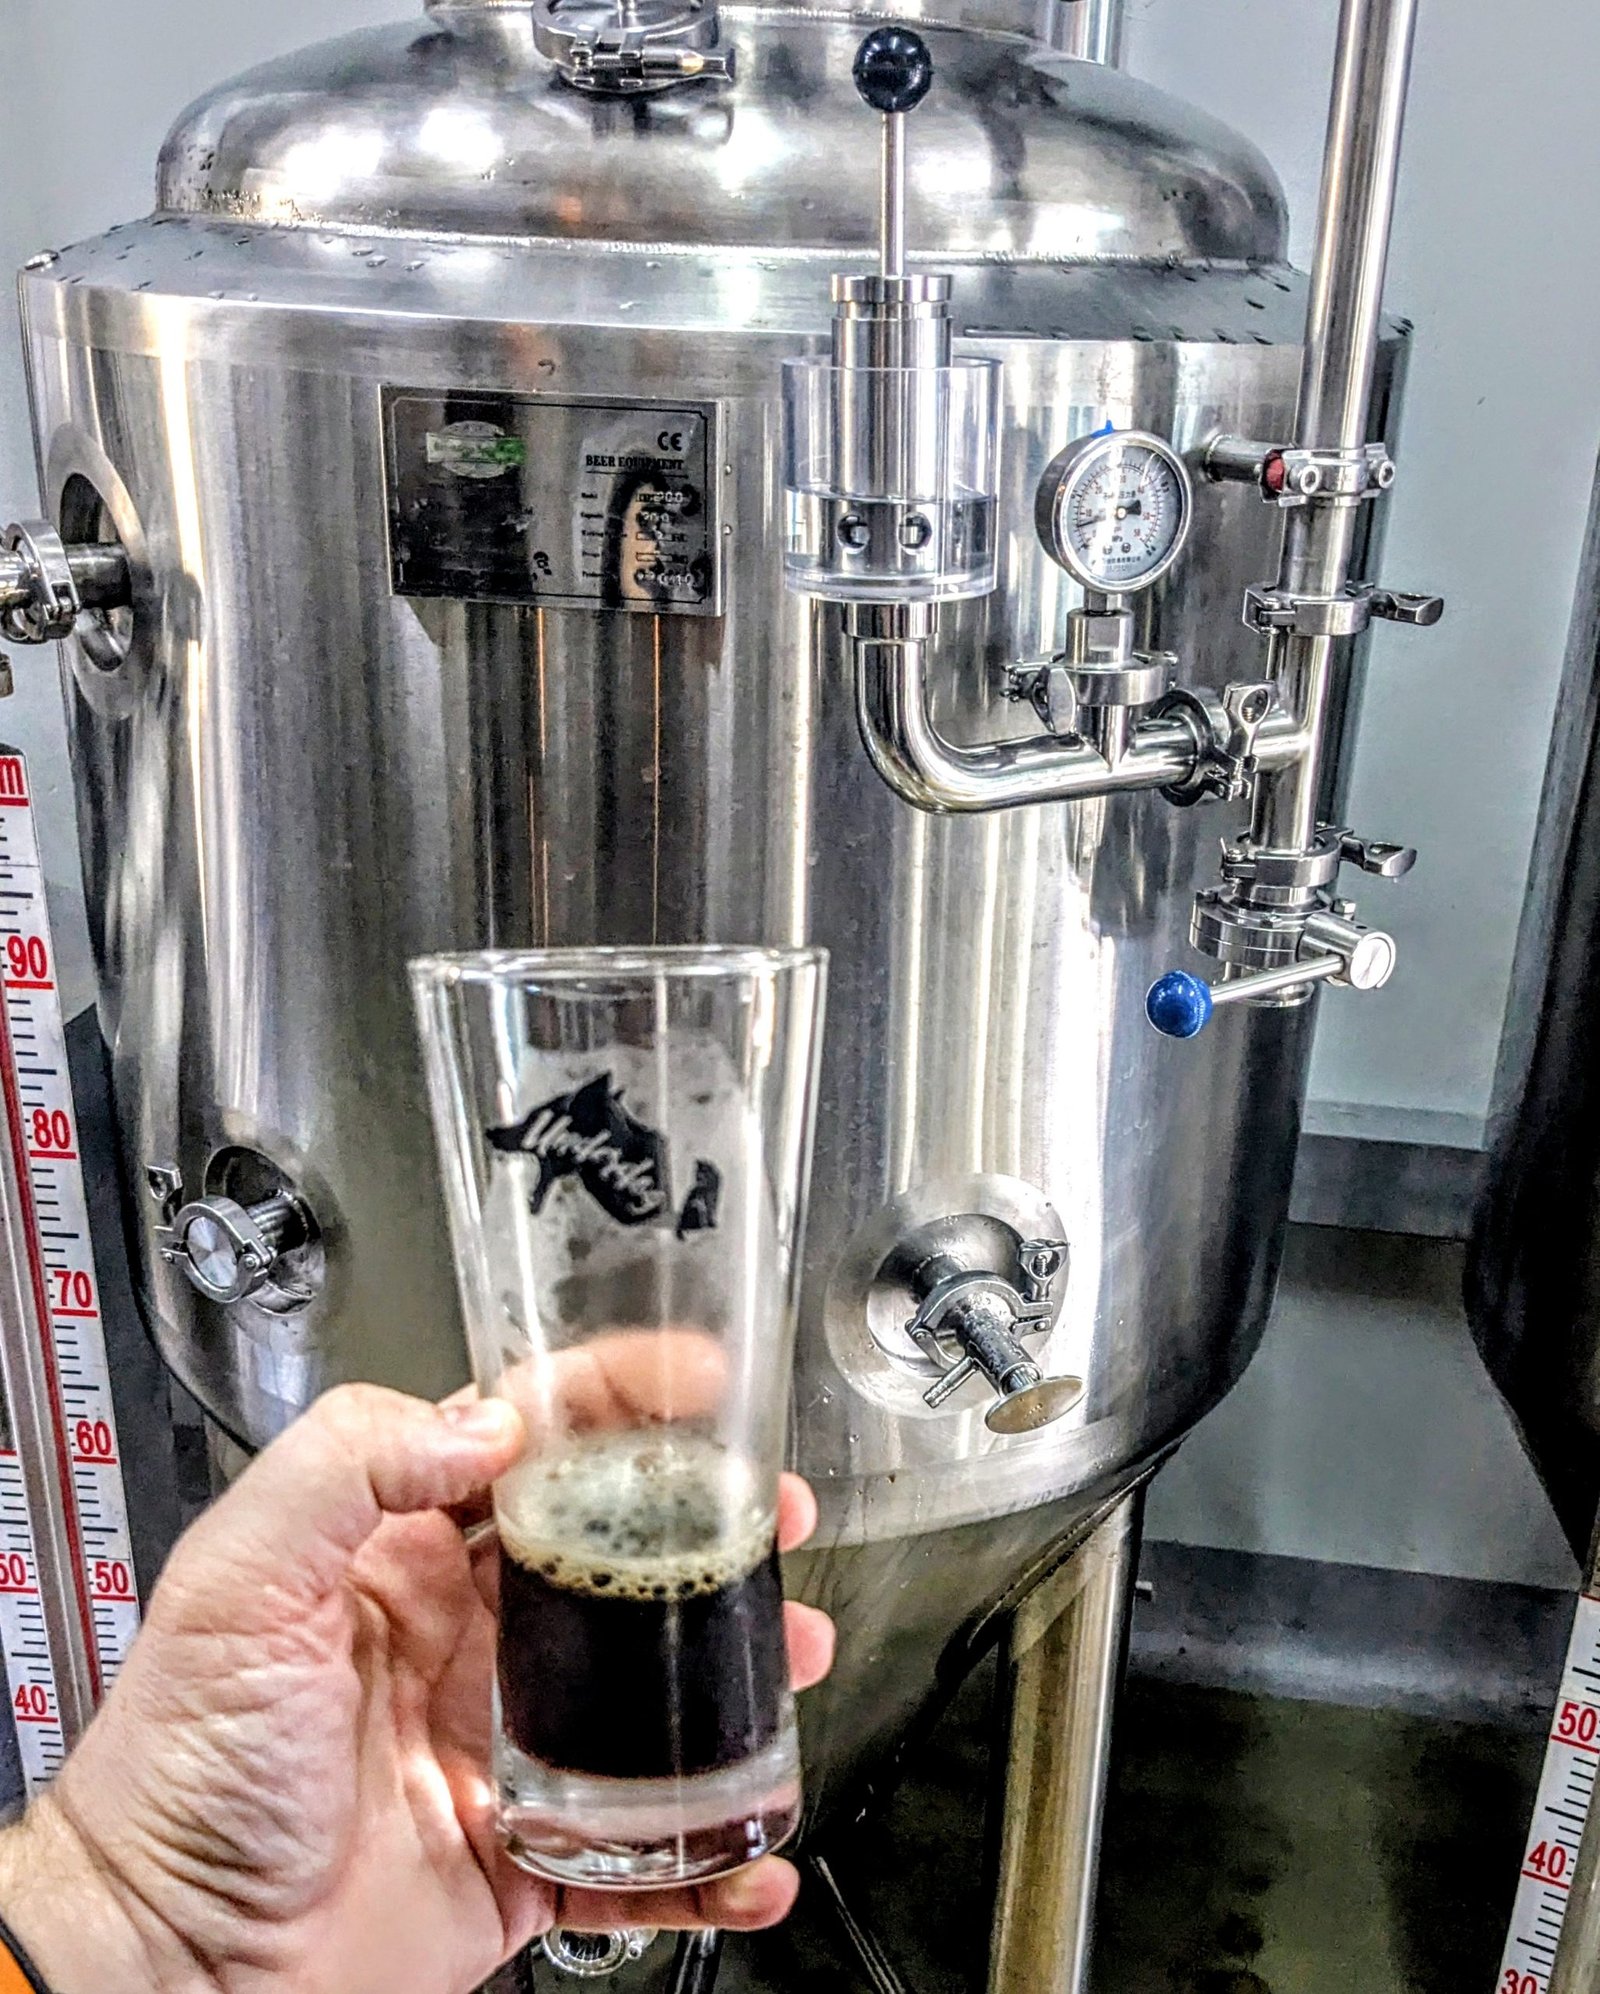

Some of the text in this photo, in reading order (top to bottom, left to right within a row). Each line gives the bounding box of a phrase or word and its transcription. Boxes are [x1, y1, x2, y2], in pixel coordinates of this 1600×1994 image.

[658, 431, 682, 452] CE
[585, 454, 616, 468] BEER
[7, 935, 47, 978] 90
[32, 1109, 71, 1149] 80
[54, 1270, 92, 1308] 70
[76, 1420, 111, 1455] 60
[95, 1561, 129, 1594] 50
[15, 1684, 47, 1715] 40
[1558, 1701, 1597, 1741] 50
[1528, 1841, 1566, 1878] 40
[1501, 1969, 1537, 1994] 30
